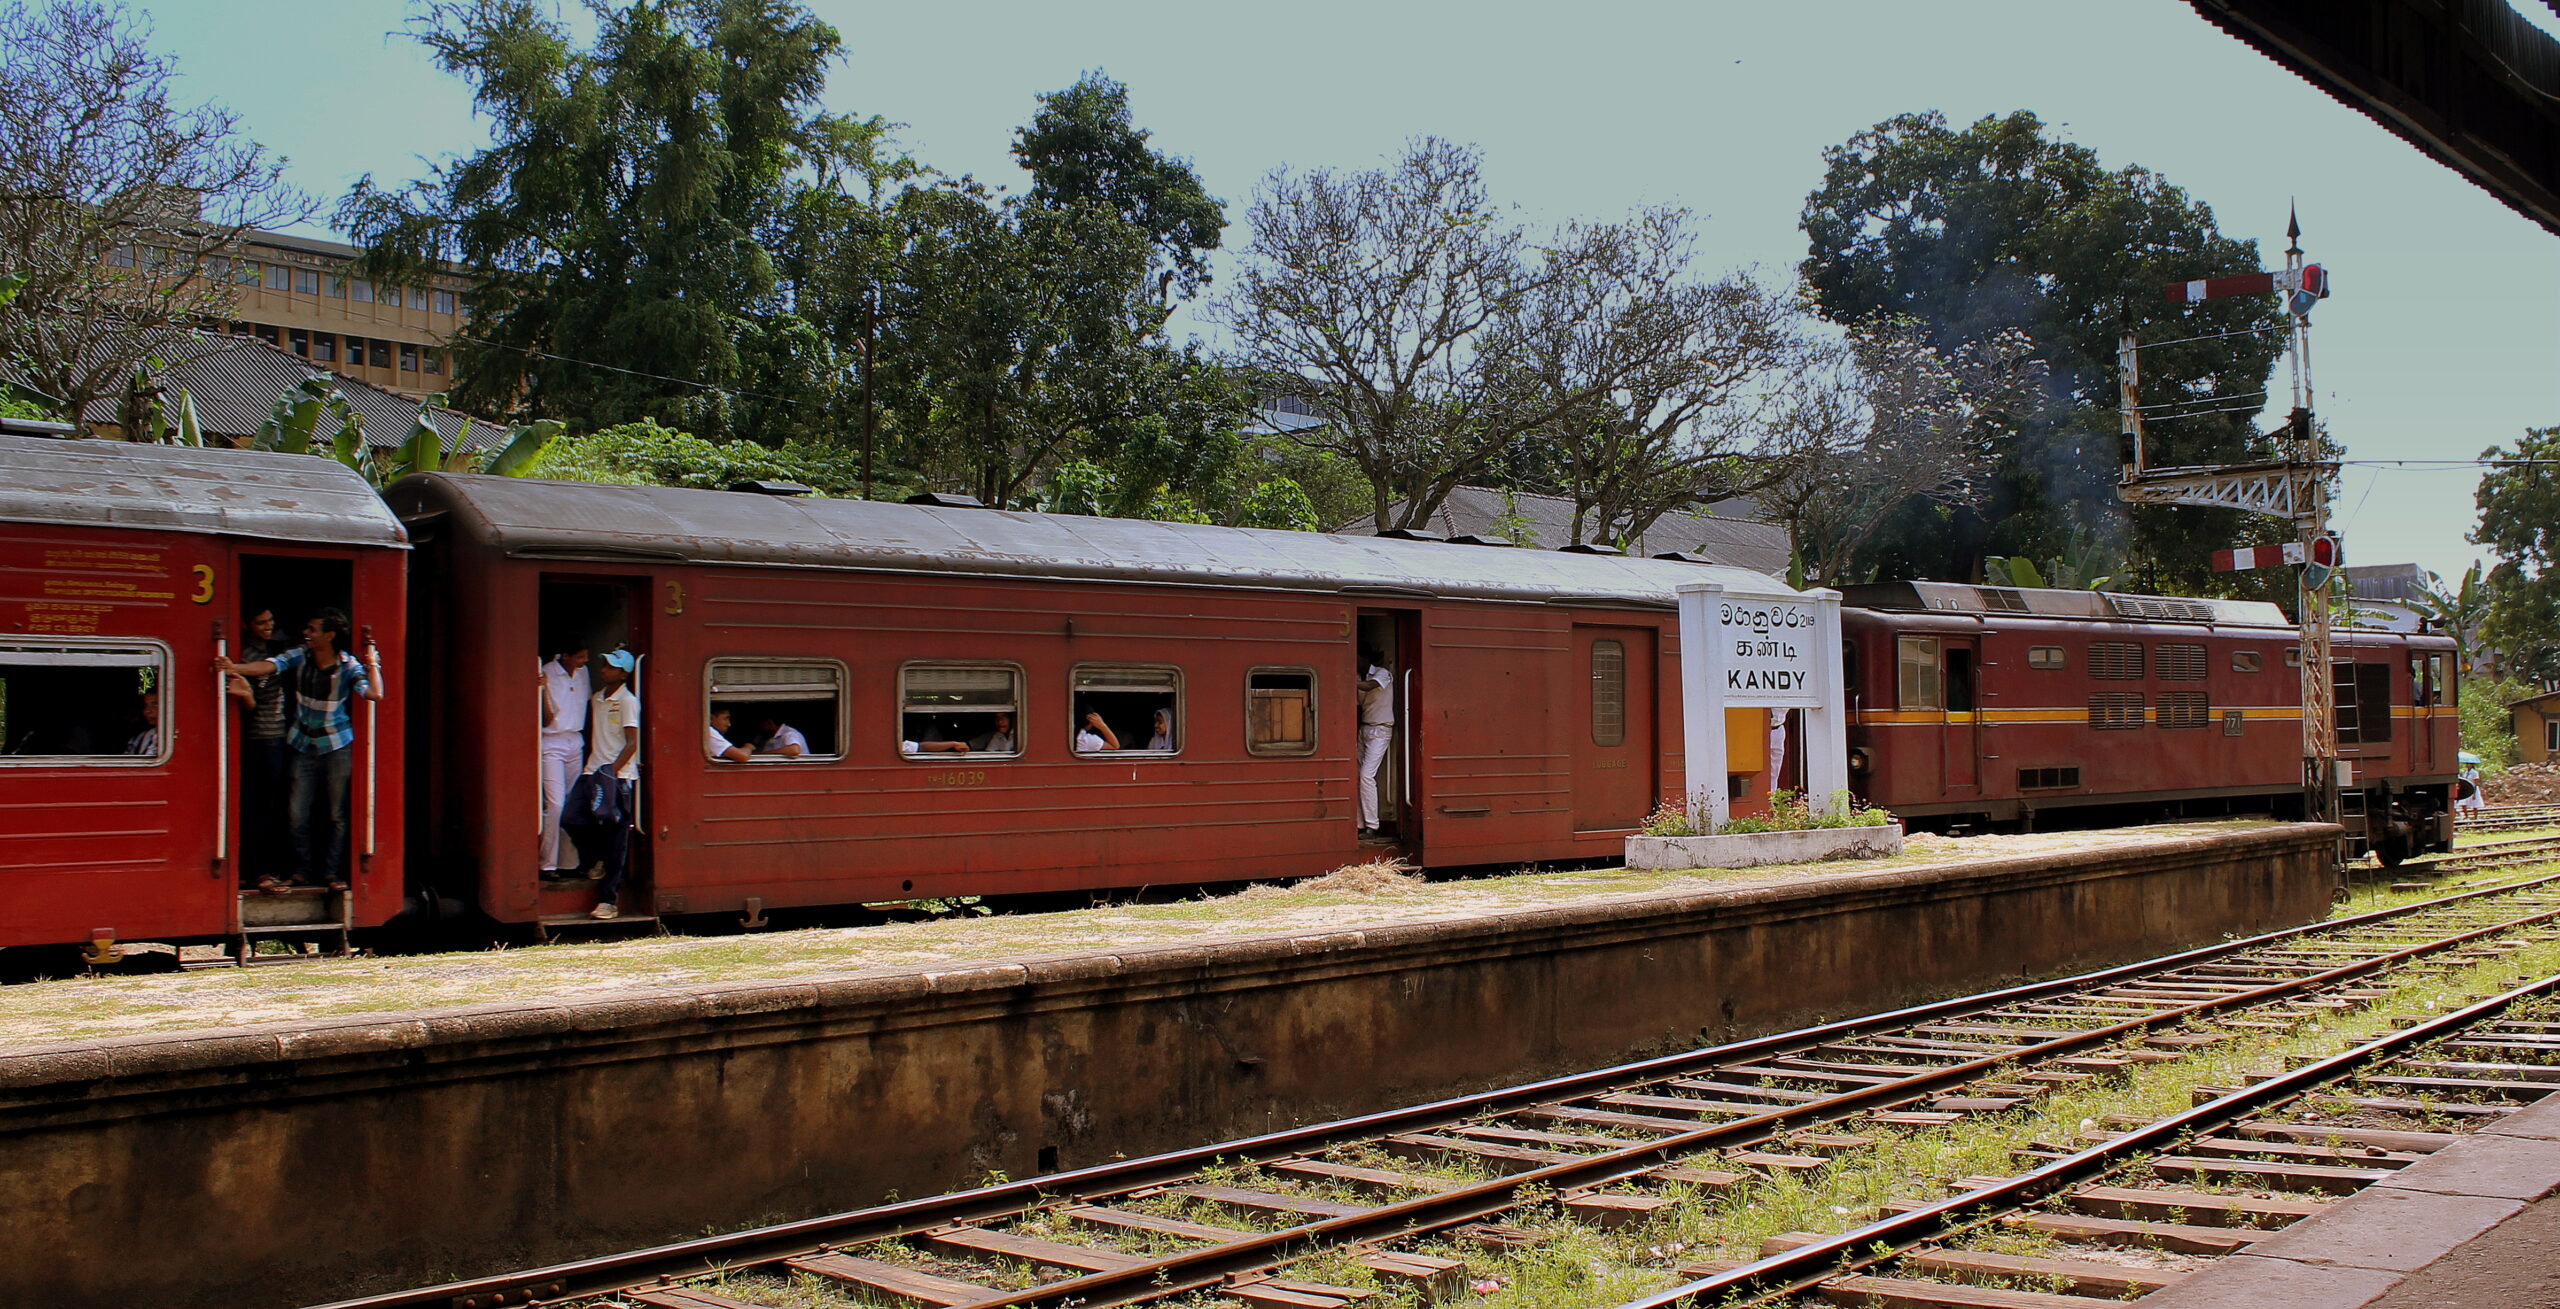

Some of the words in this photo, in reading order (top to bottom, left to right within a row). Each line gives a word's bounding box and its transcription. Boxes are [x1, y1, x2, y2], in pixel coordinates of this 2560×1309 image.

[192, 564, 215, 604] 3
[664, 580, 683, 616] 3
[1339, 609, 1350, 637] 3
[1727, 669, 1806, 690] KANDY
[2225, 717, 2240, 729] 771
